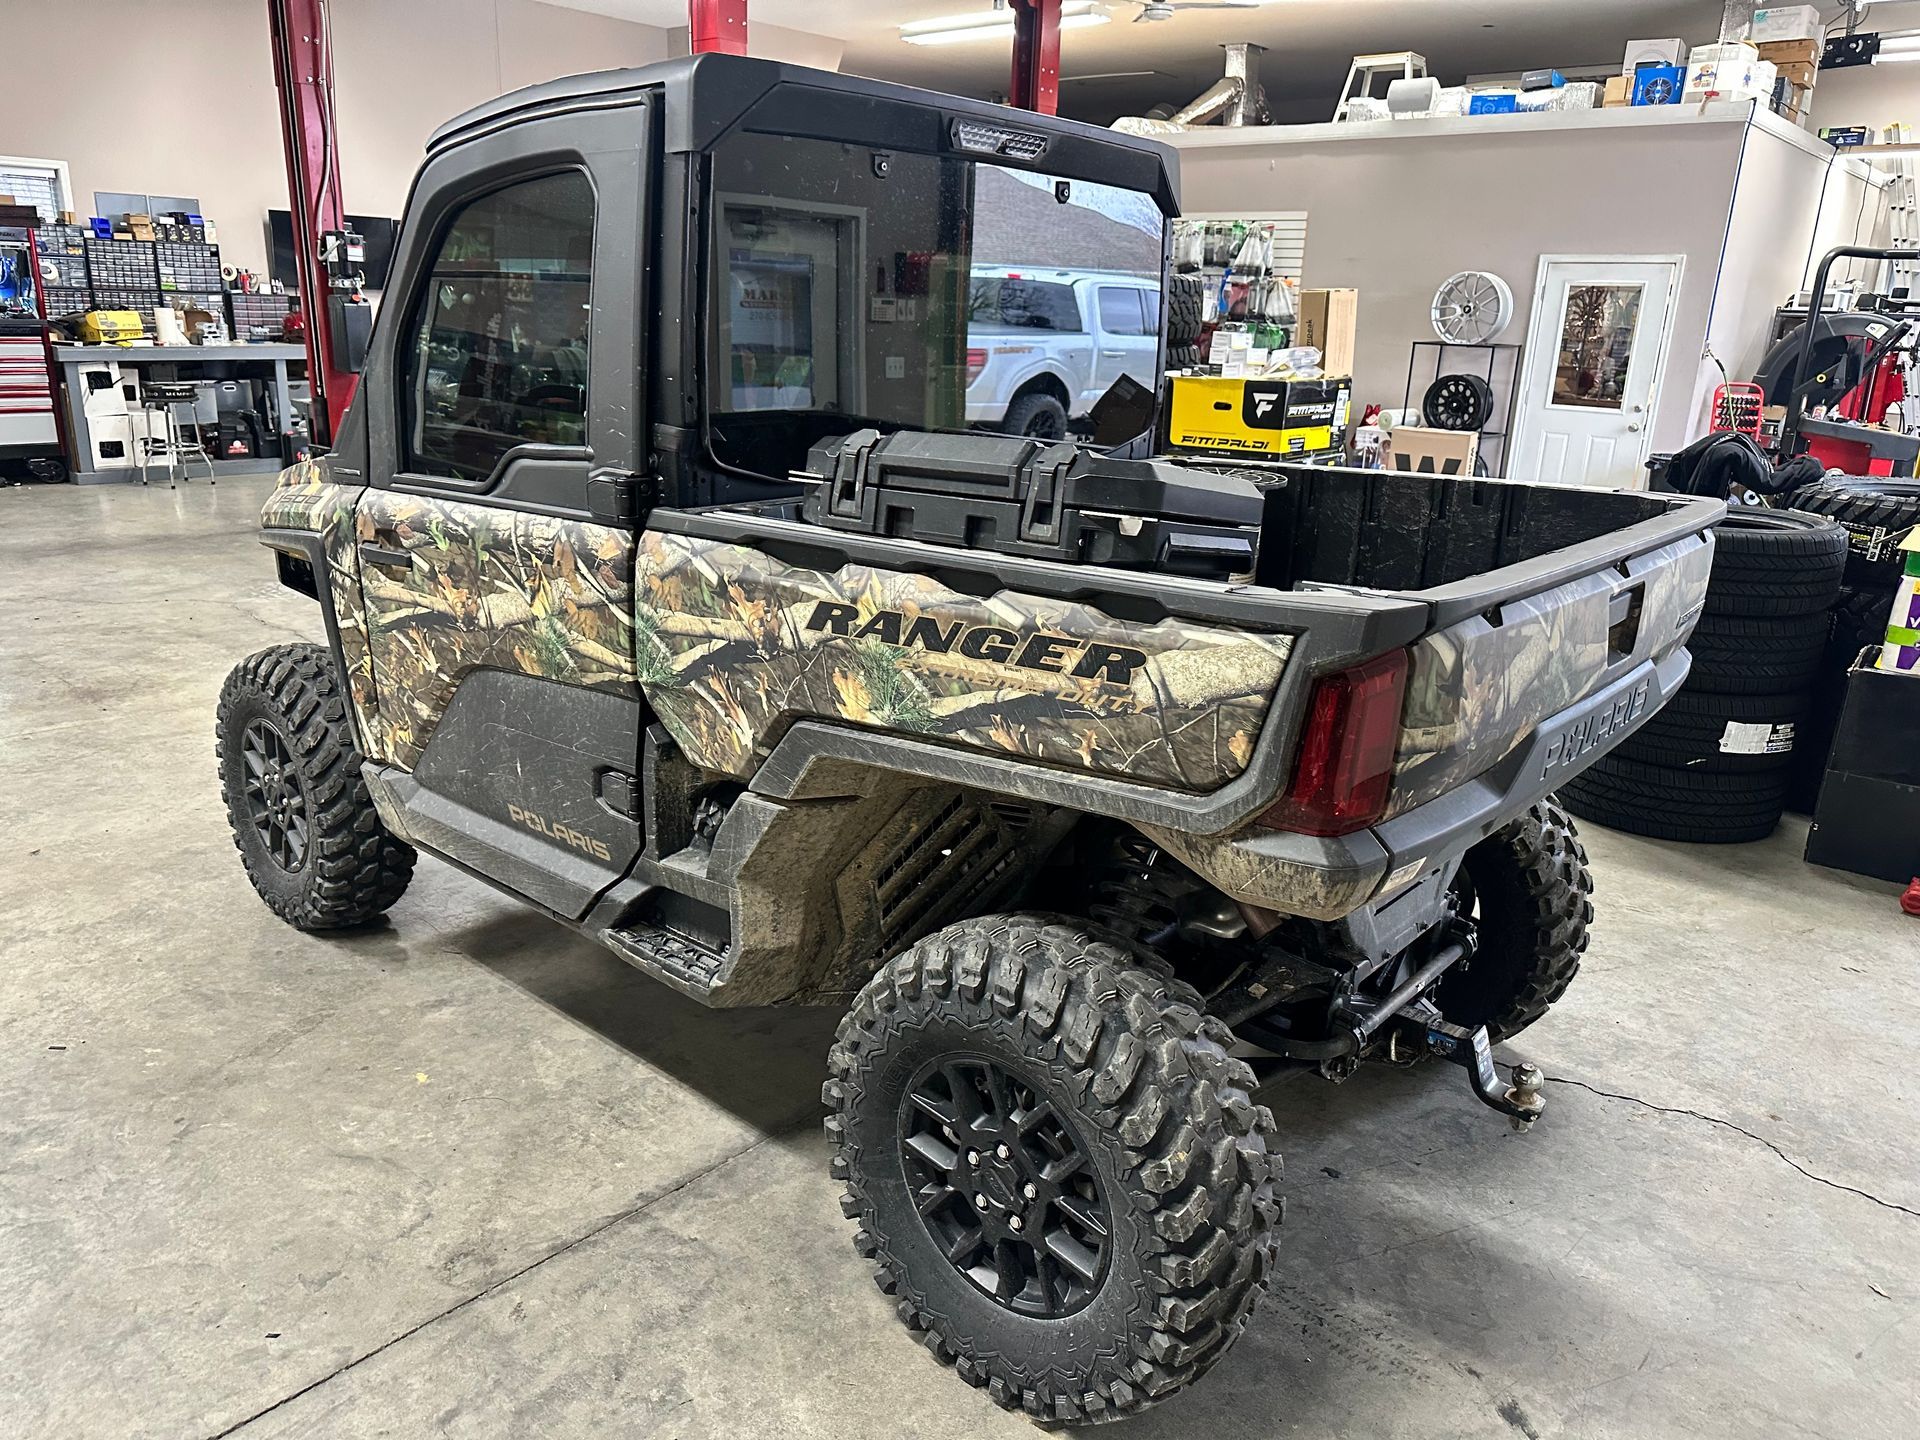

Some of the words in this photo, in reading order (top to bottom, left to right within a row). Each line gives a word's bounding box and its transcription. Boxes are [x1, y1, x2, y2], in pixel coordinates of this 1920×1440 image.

[1180, 435, 1270, 450] FITTIPALDI
[805, 599, 1147, 687] RANGER
[1055, 688, 1154, 714] DUTY
[1539, 677, 1650, 782] POLARIS
[507, 803, 612, 862] POLARIS
